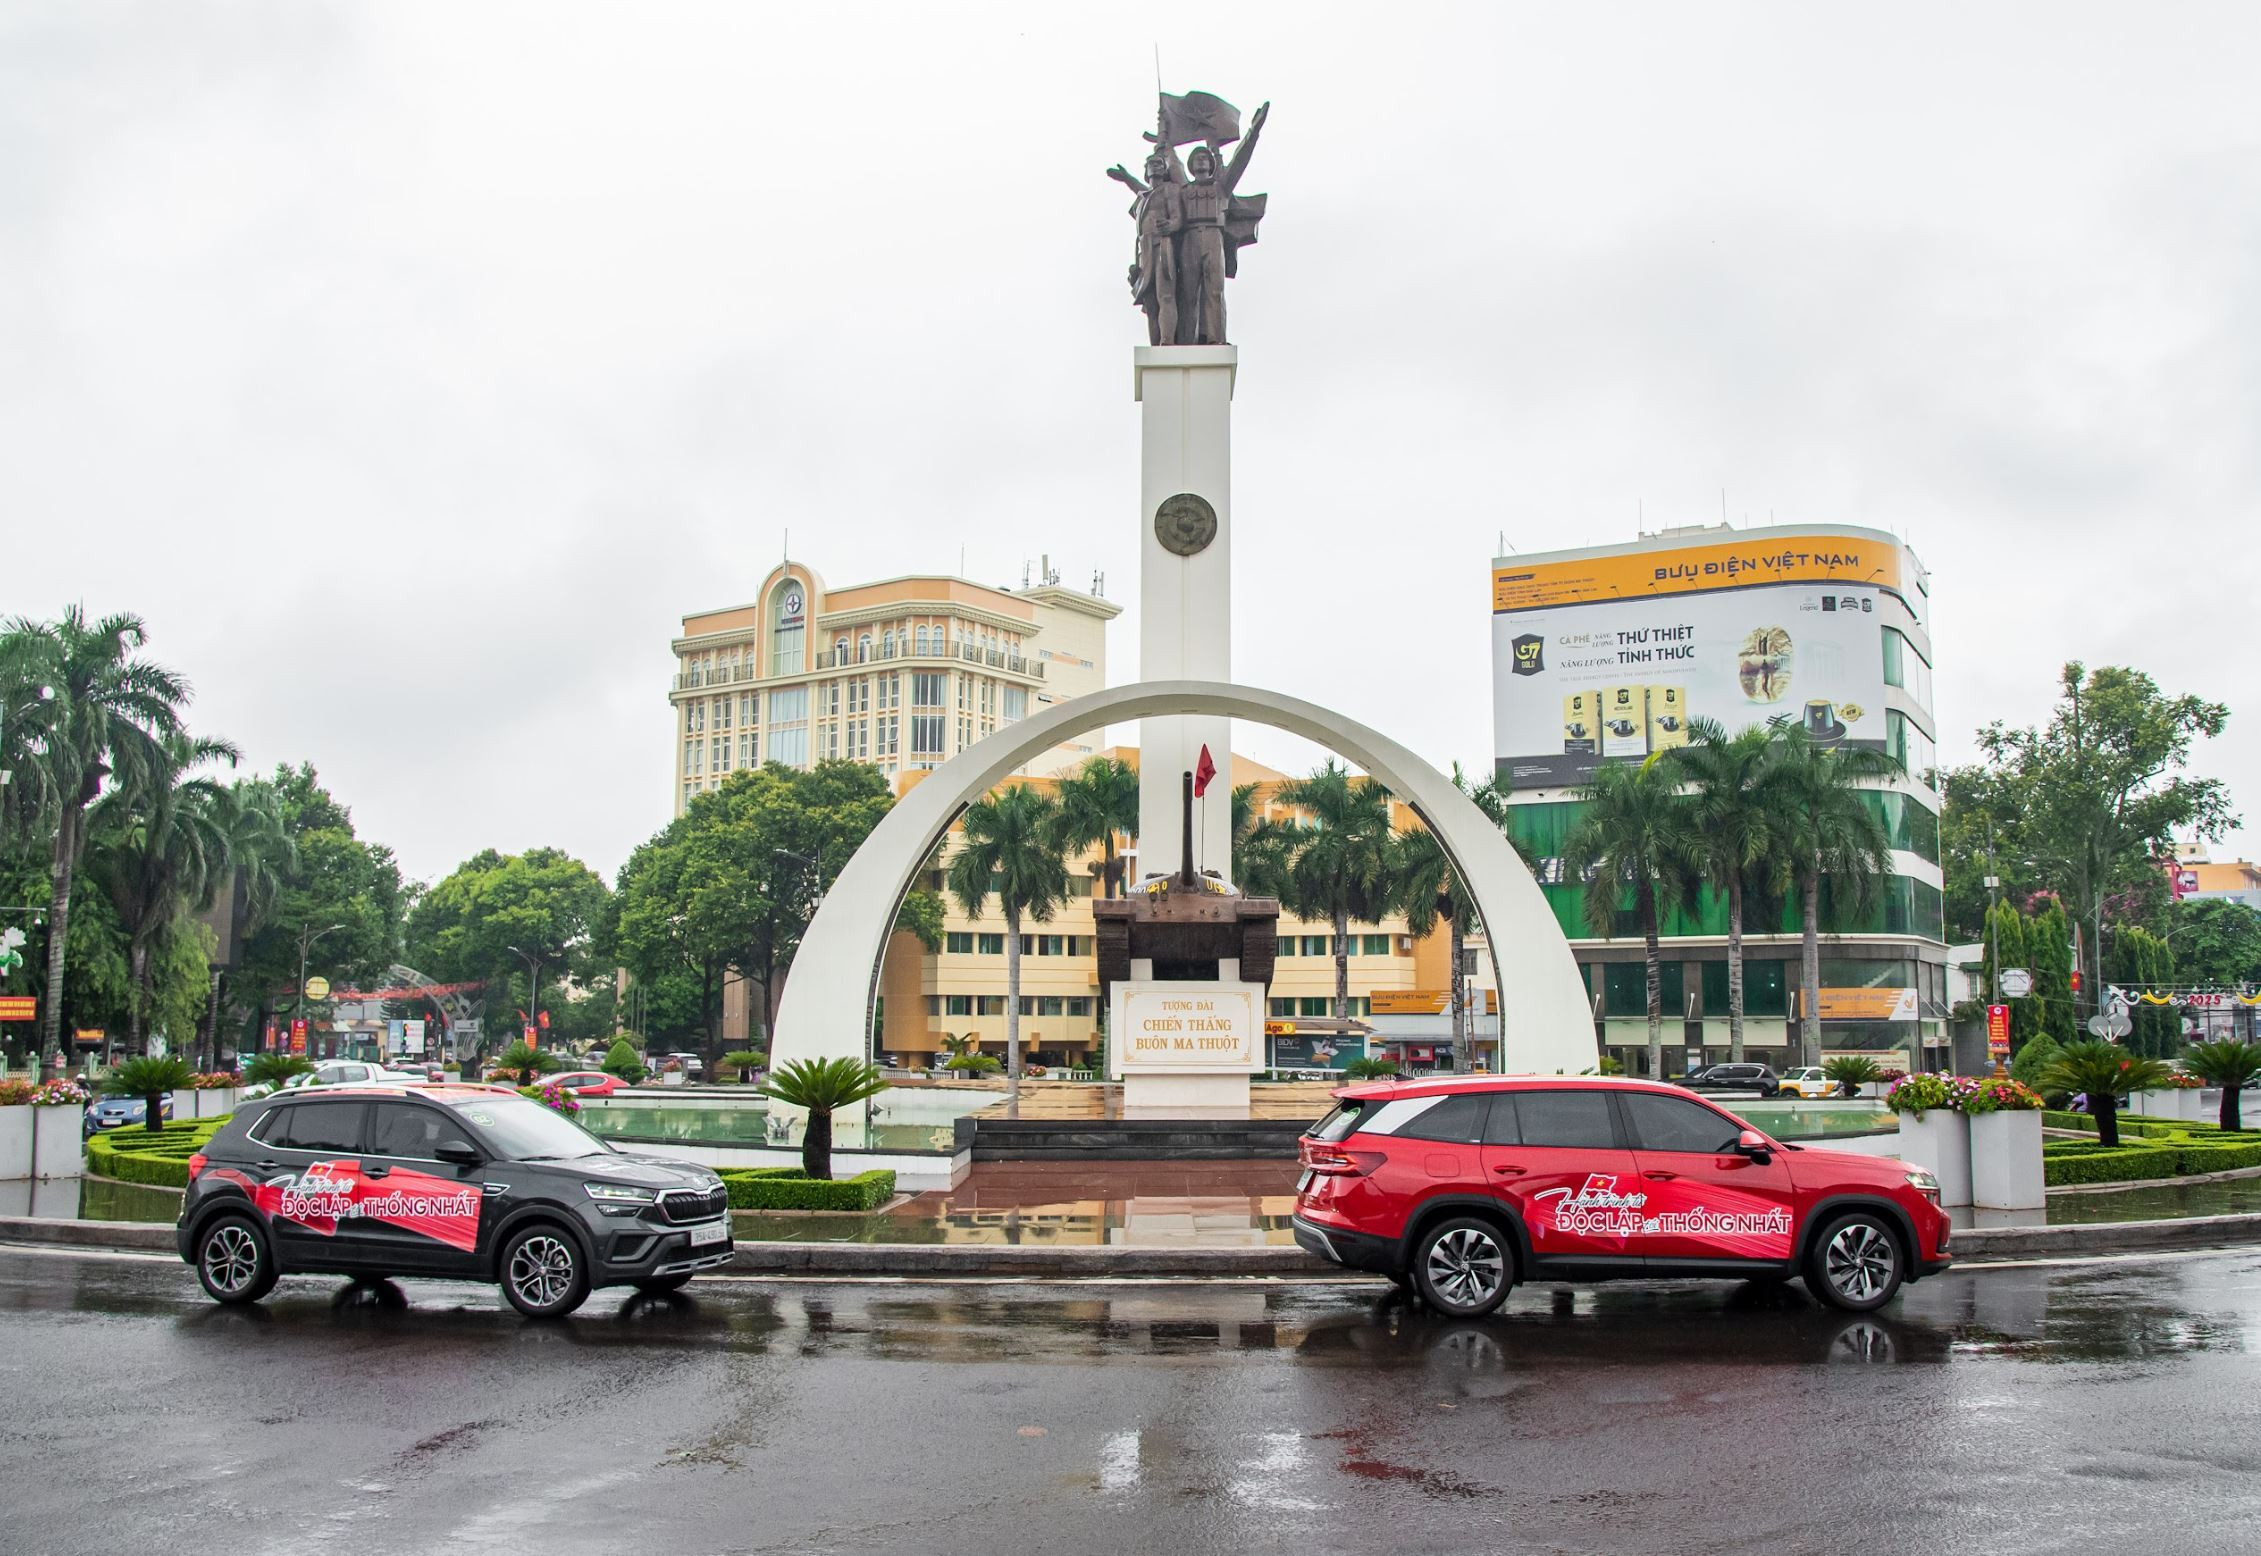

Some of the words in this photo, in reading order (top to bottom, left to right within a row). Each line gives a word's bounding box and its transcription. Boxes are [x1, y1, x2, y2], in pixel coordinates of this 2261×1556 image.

[1654, 563, 1698, 580] BƯU
[1704, 556, 1756, 575] ĐIỆN
[1762, 551, 1809, 570] VIỆT
[1814, 554, 1859, 568] NAM
[1617, 628, 1650, 646] THỨ
[1652, 624, 1694, 642] THIỆT
[1656, 644, 1695, 662] THỨC
[2188, 994, 2222, 1005] 2025
[1143, 1015, 1182, 1031] CHIẾN
[1187, 1015, 1232, 1031] THẮNG
[1135, 1035, 1168, 1049] BUÔN
[1174, 1038, 1194, 1049] MA
[1198, 1035, 1240, 1052] THUỘT
[281, 1193, 321, 1221] ĐỘC
[321, 1193, 351, 1221] LẬP
[364, 1191, 427, 1217] THỐNG
[428, 1190, 478, 1217] NHẤT
[1556, 1206, 1606, 1236] ĐỘC
[1606, 1207, 1642, 1237] LẬP
[1658, 1207, 1736, 1233] THỐNG
[1736, 1207, 1792, 1234] NHẤT
